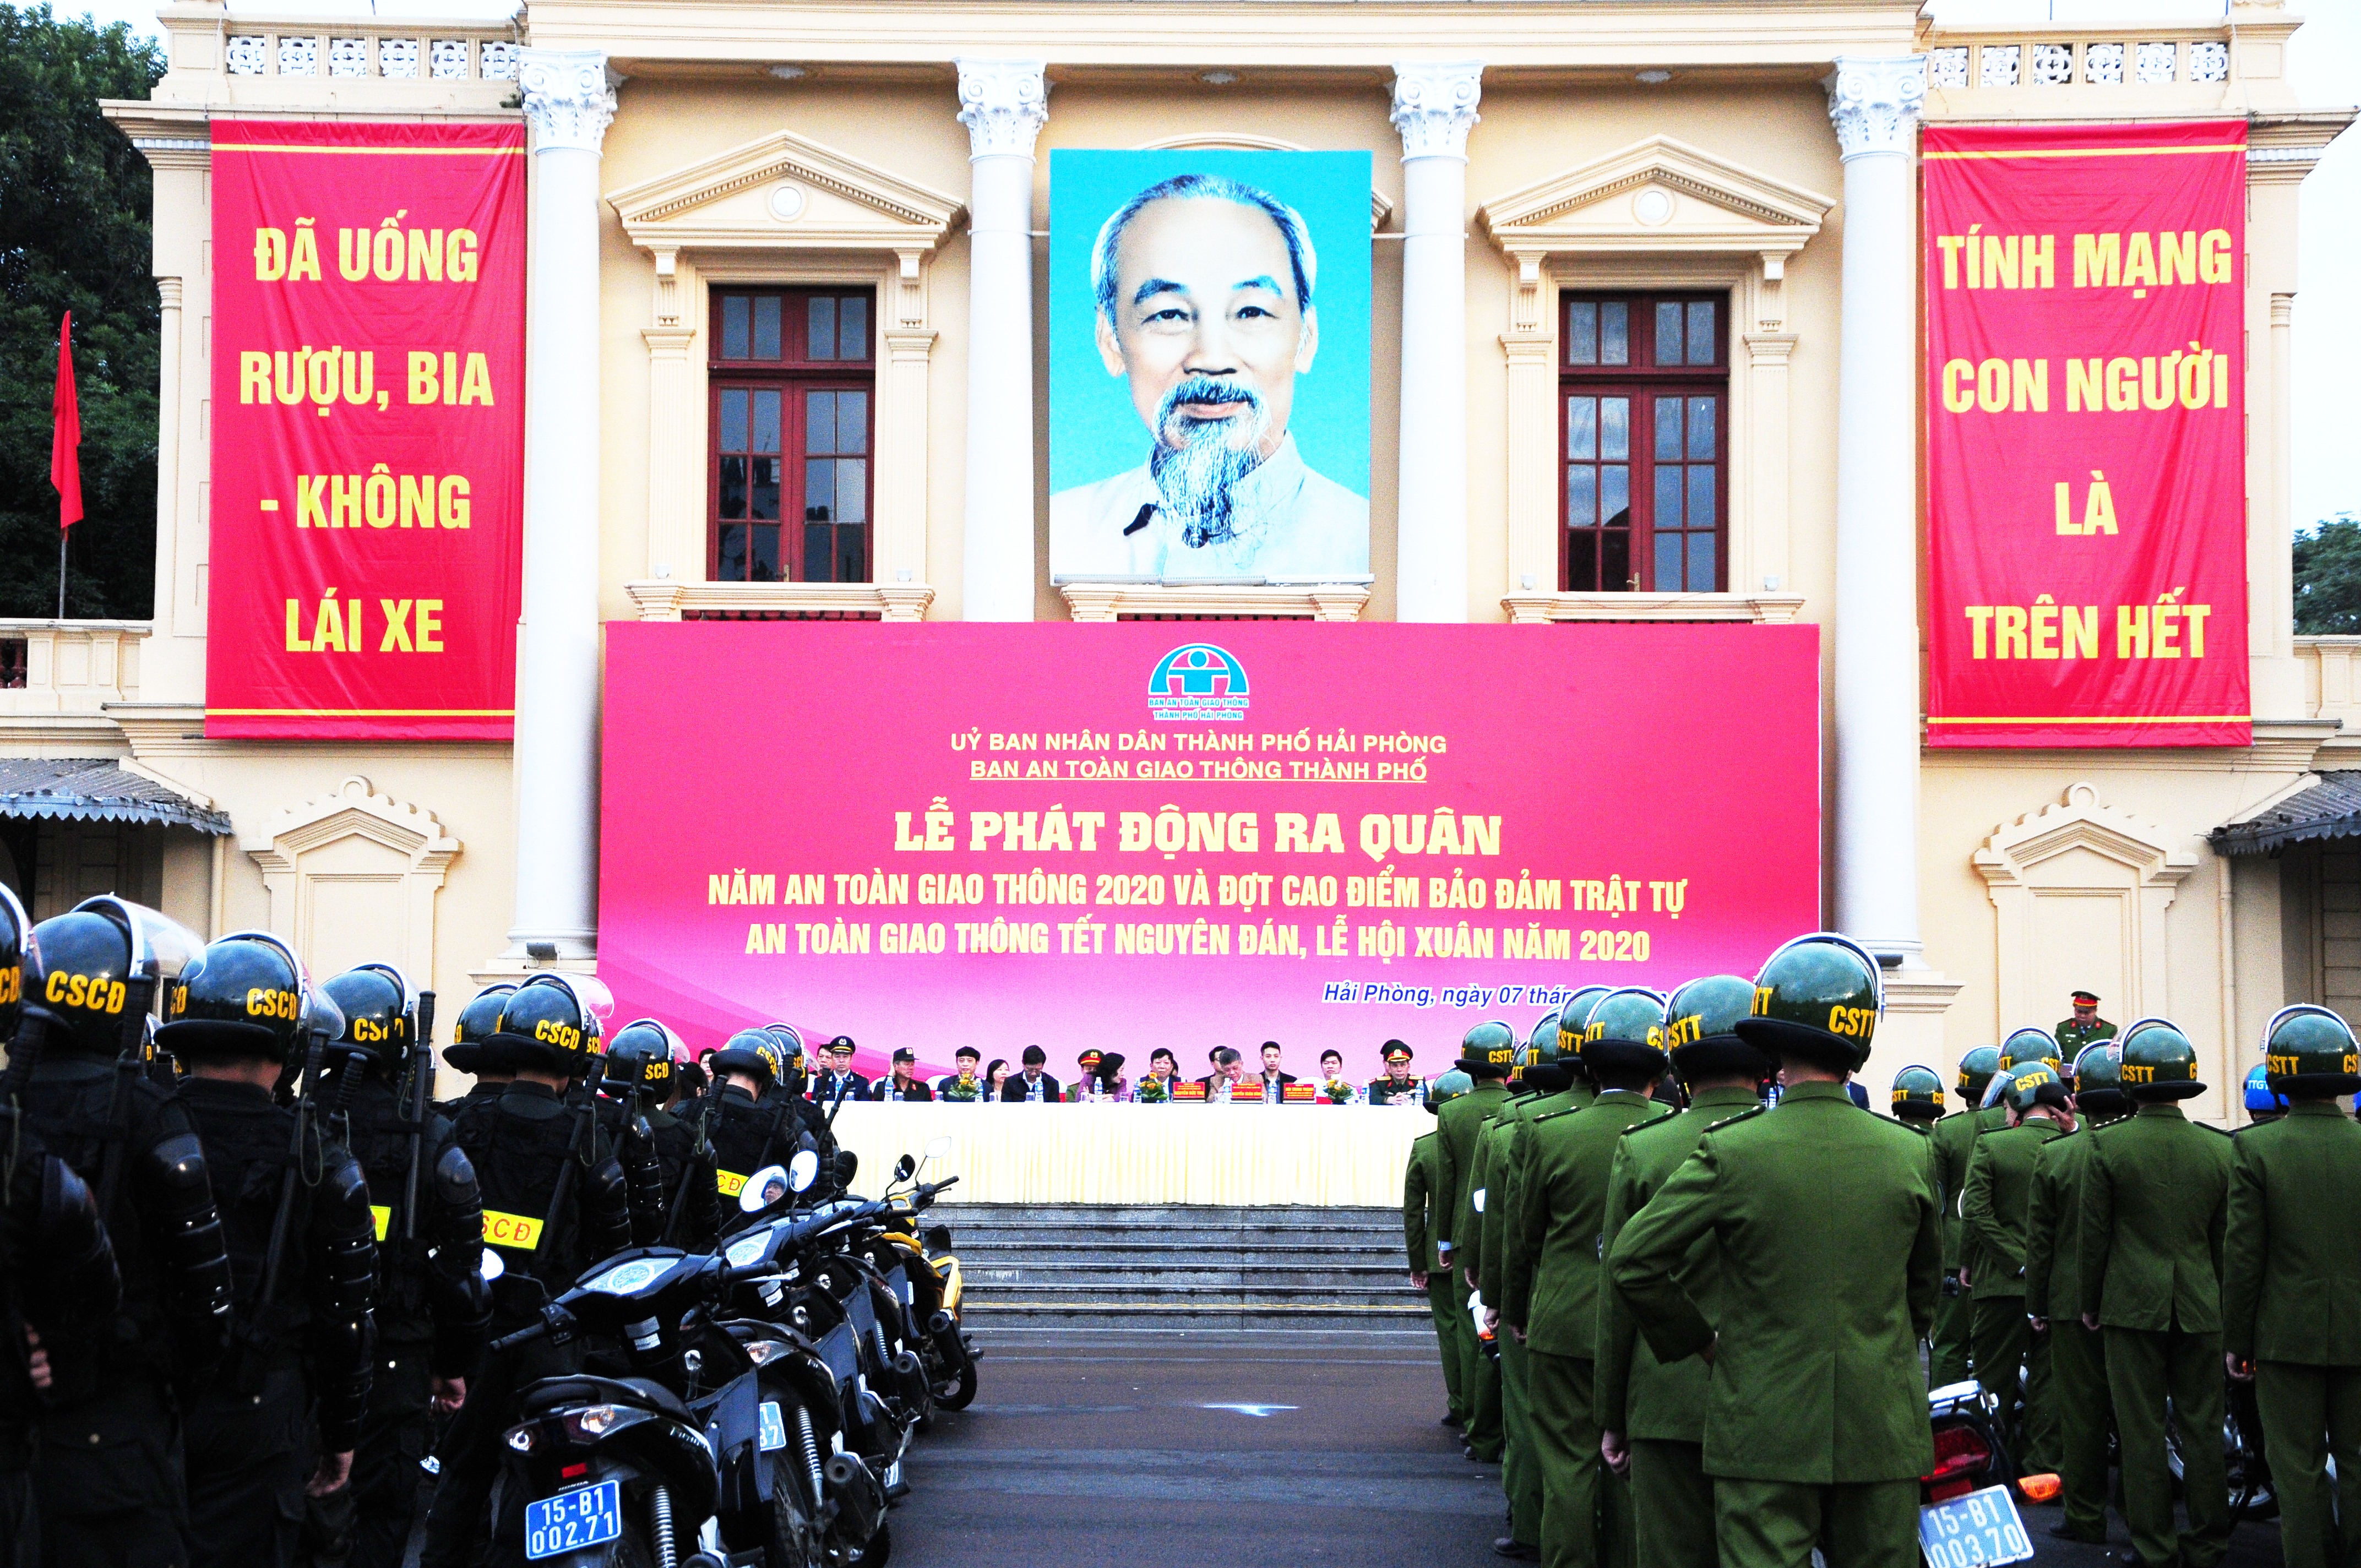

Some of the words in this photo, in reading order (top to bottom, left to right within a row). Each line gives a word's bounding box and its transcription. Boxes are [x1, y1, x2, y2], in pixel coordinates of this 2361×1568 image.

[254, 217, 322, 281] ĐÃ
[339, 209, 477, 282] UỐNG
[1937, 224, 2054, 289] TÍNH
[2074, 228, 2232, 298] MẠNG
[241, 346, 388, 416] RƯỢU,
[408, 351, 494, 406] BIA
[1942, 358, 2048, 413] CON
[2066, 341, 2228, 412] NGƯỜI
[261, 500, 278, 510] -
[297, 464, 470, 529] KHÔNG
[2055, 470, 2119, 535] LÀ
[286, 587, 361, 652] LÁI
[380, 599, 443, 652] XE
[1965, 594, 2098, 659] TRÊN
[2118, 587, 2211, 658] HẾT
[1149, 698, 1165, 706] BAN
[1166, 698, 1177, 706] AN
[1201, 698, 1220, 706] GIAO
[951, 727, 982, 751] UỶ
[990, 733, 1037, 750] BAN
[1046, 729, 1110, 750] NHÂN
[1118, 729, 1166, 750] DÂN
[1173, 729, 1253, 751] THÀNH
[1262, 727, 1310, 752] PHỐ
[1318, 728, 1355, 752] HẢI
[1364, 731, 1446, 753] PHÒNG
[971, 760, 1019, 776] BAN
[1026, 760, 1058, 776] AN
[1065, 756, 1128, 776] TOÀN
[1136, 760, 1193, 777] GIAO
[1200, 756, 1282, 778] THÔNG
[1291, 757, 1369, 778] THÀNH
[1378, 756, 1427, 780] PHỐ
[895, 796, 954, 851] LỄ
[970, 803, 1105, 851] PHÁT
[1119, 804, 1258, 859] ĐỘNG
[1275, 813, 1345, 853] RA
[1360, 806, 1502, 862] QUÂN
[709, 868, 775, 905] NĂM
[784, 874, 825, 905] AN
[834, 868, 909, 905] TOÀN
[918, 874, 983, 904] GIAO
[993, 867, 1087, 905] THÔNG
[1096, 874, 1165, 905] 2020
[1173, 868, 1210, 905] VÀ
[1218, 872, 1273, 912] ĐỢT
[1282, 875, 1337, 906] CAO
[1346, 864, 1419, 908] ĐIỂM
[1429, 868, 1486, 909] BẢO
[1495, 869, 1561, 910] ĐẢM
[1570, 874, 1641, 918] TRẬT
[1649, 879, 1688, 919] TỰ
[745, 924, 786, 955] AN
[795, 917, 870, 955] TOÀN
[879, 923, 946, 955] GIAO
[954, 916, 1050, 954] THÔNG
[1057, 913, 1107, 954] TẾT
[1116, 918, 1230, 955] NGUYÊN
[1238, 918, 1307, 960] ĐÁN,
[1316, 914, 1348, 957] LỄ
[1358, 919, 1406, 965] HỘI
[1414, 921, 1494, 960] XUÂN
[1503, 922, 1570, 960] NĂM
[1580, 930, 1650, 962] 2020
[1325, 982, 1358, 1001] Hải
[1364, 984, 1434, 1006] Phòng,
[1443, 986, 1493, 1007] ngày
[1499, 987, 1523, 1003] 07
[1829, 1005, 1875, 1038] CSTT
[2015, 1071, 2049, 1092] CSTT
[2122, 1064, 2155, 1082] CSTT
[542, 1487, 603, 1526] 15-B1
[1928, 1495, 2000, 1537] 15-B1
[532, 1511, 613, 1554] 002.71
[1931, 1523, 2023, 1568] 003.70
